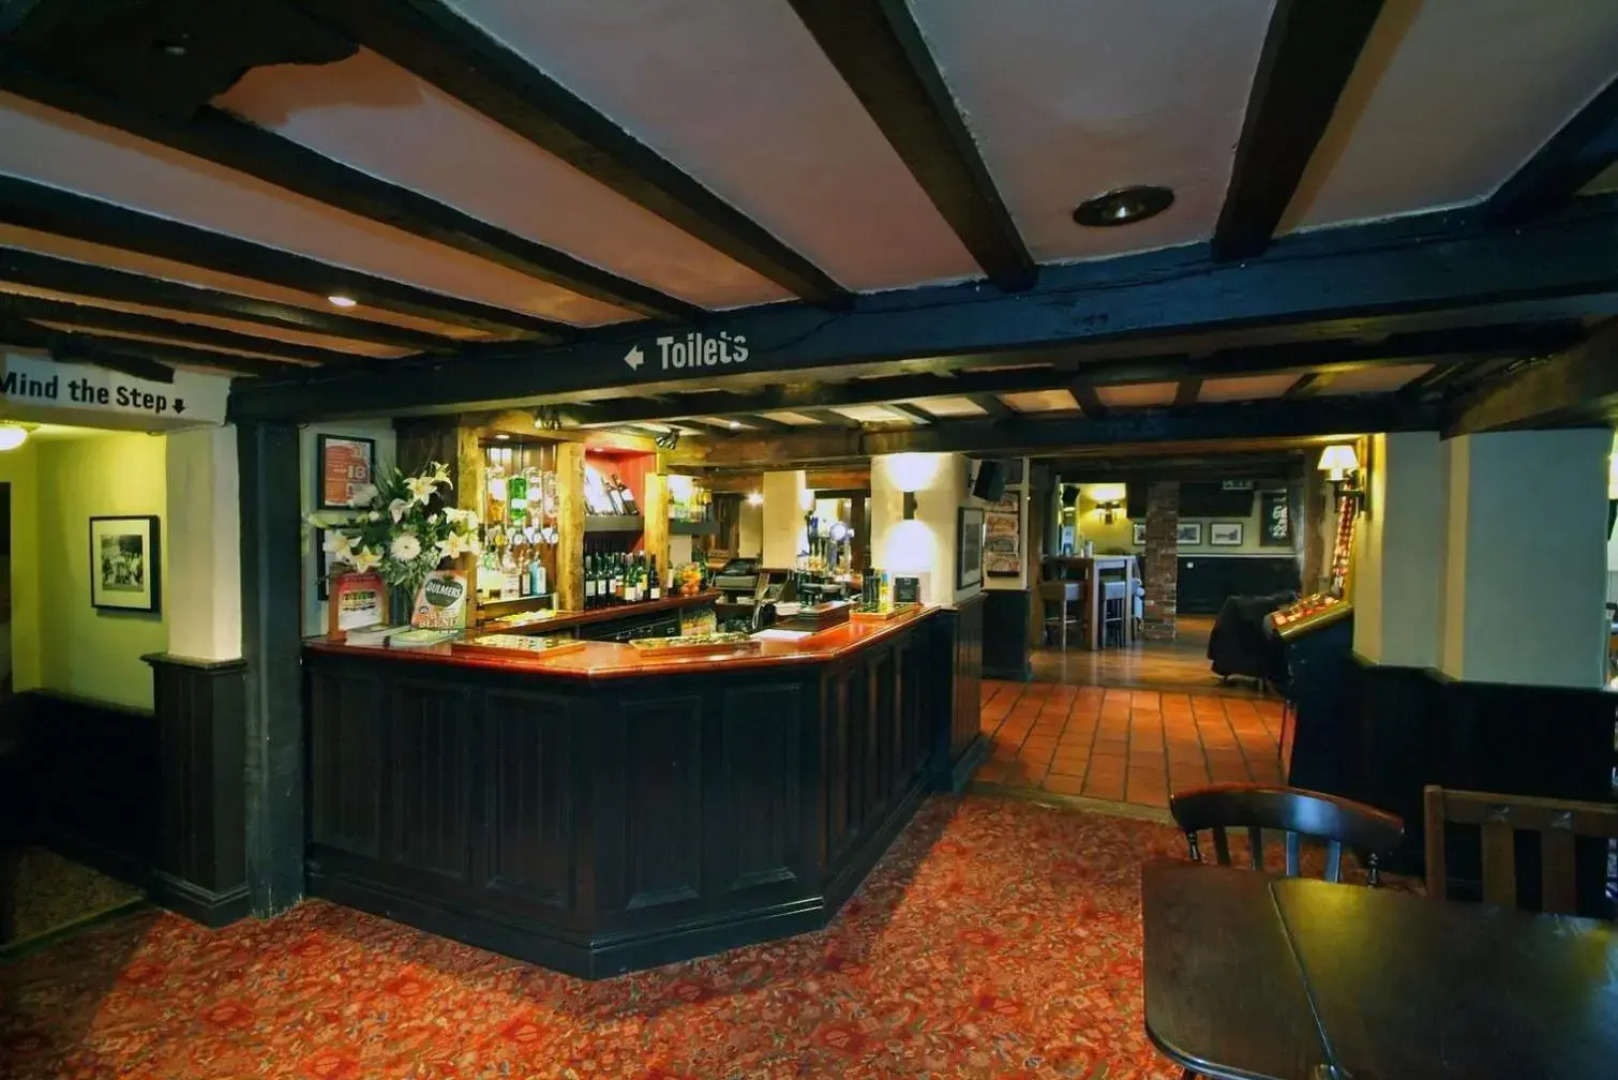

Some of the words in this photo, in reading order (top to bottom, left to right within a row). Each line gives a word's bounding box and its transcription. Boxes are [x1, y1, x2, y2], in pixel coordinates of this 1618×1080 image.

[656, 331, 749, 370] Toilets
[1, 371, 58, 400] Mind
[68, 379, 109, 404] the
[116, 386, 167, 413] Step
